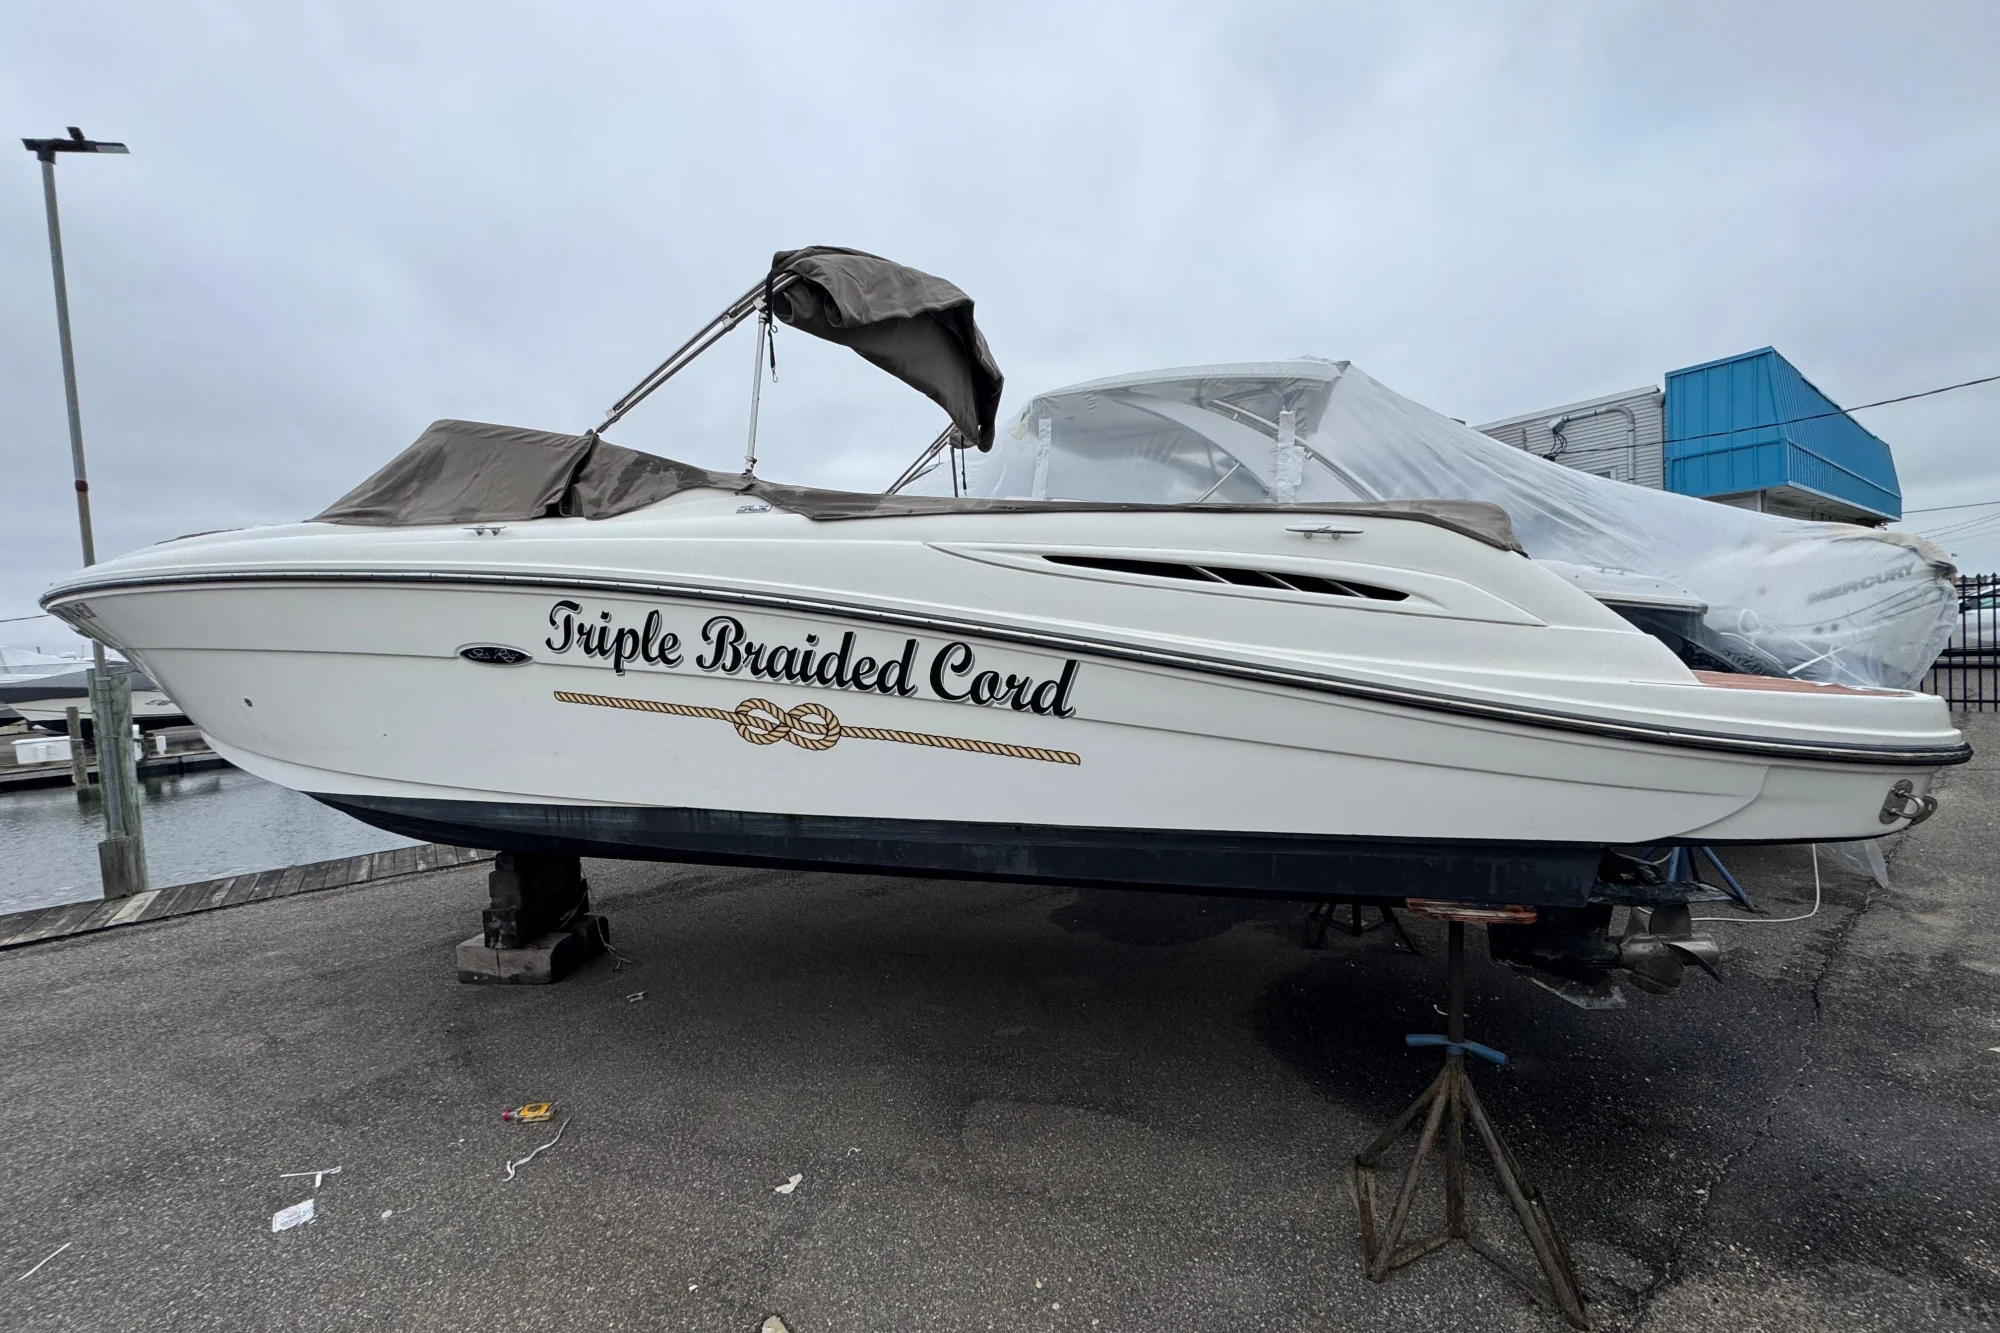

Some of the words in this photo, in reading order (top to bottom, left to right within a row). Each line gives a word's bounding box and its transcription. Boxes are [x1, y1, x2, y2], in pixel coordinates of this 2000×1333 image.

[467, 648, 493, 659] Sea
[493, 648, 519, 663] Ray
[545, 599, 685, 677] Triple
[695, 615, 920, 698] Braided
[929, 641, 1080, 719] Cord
